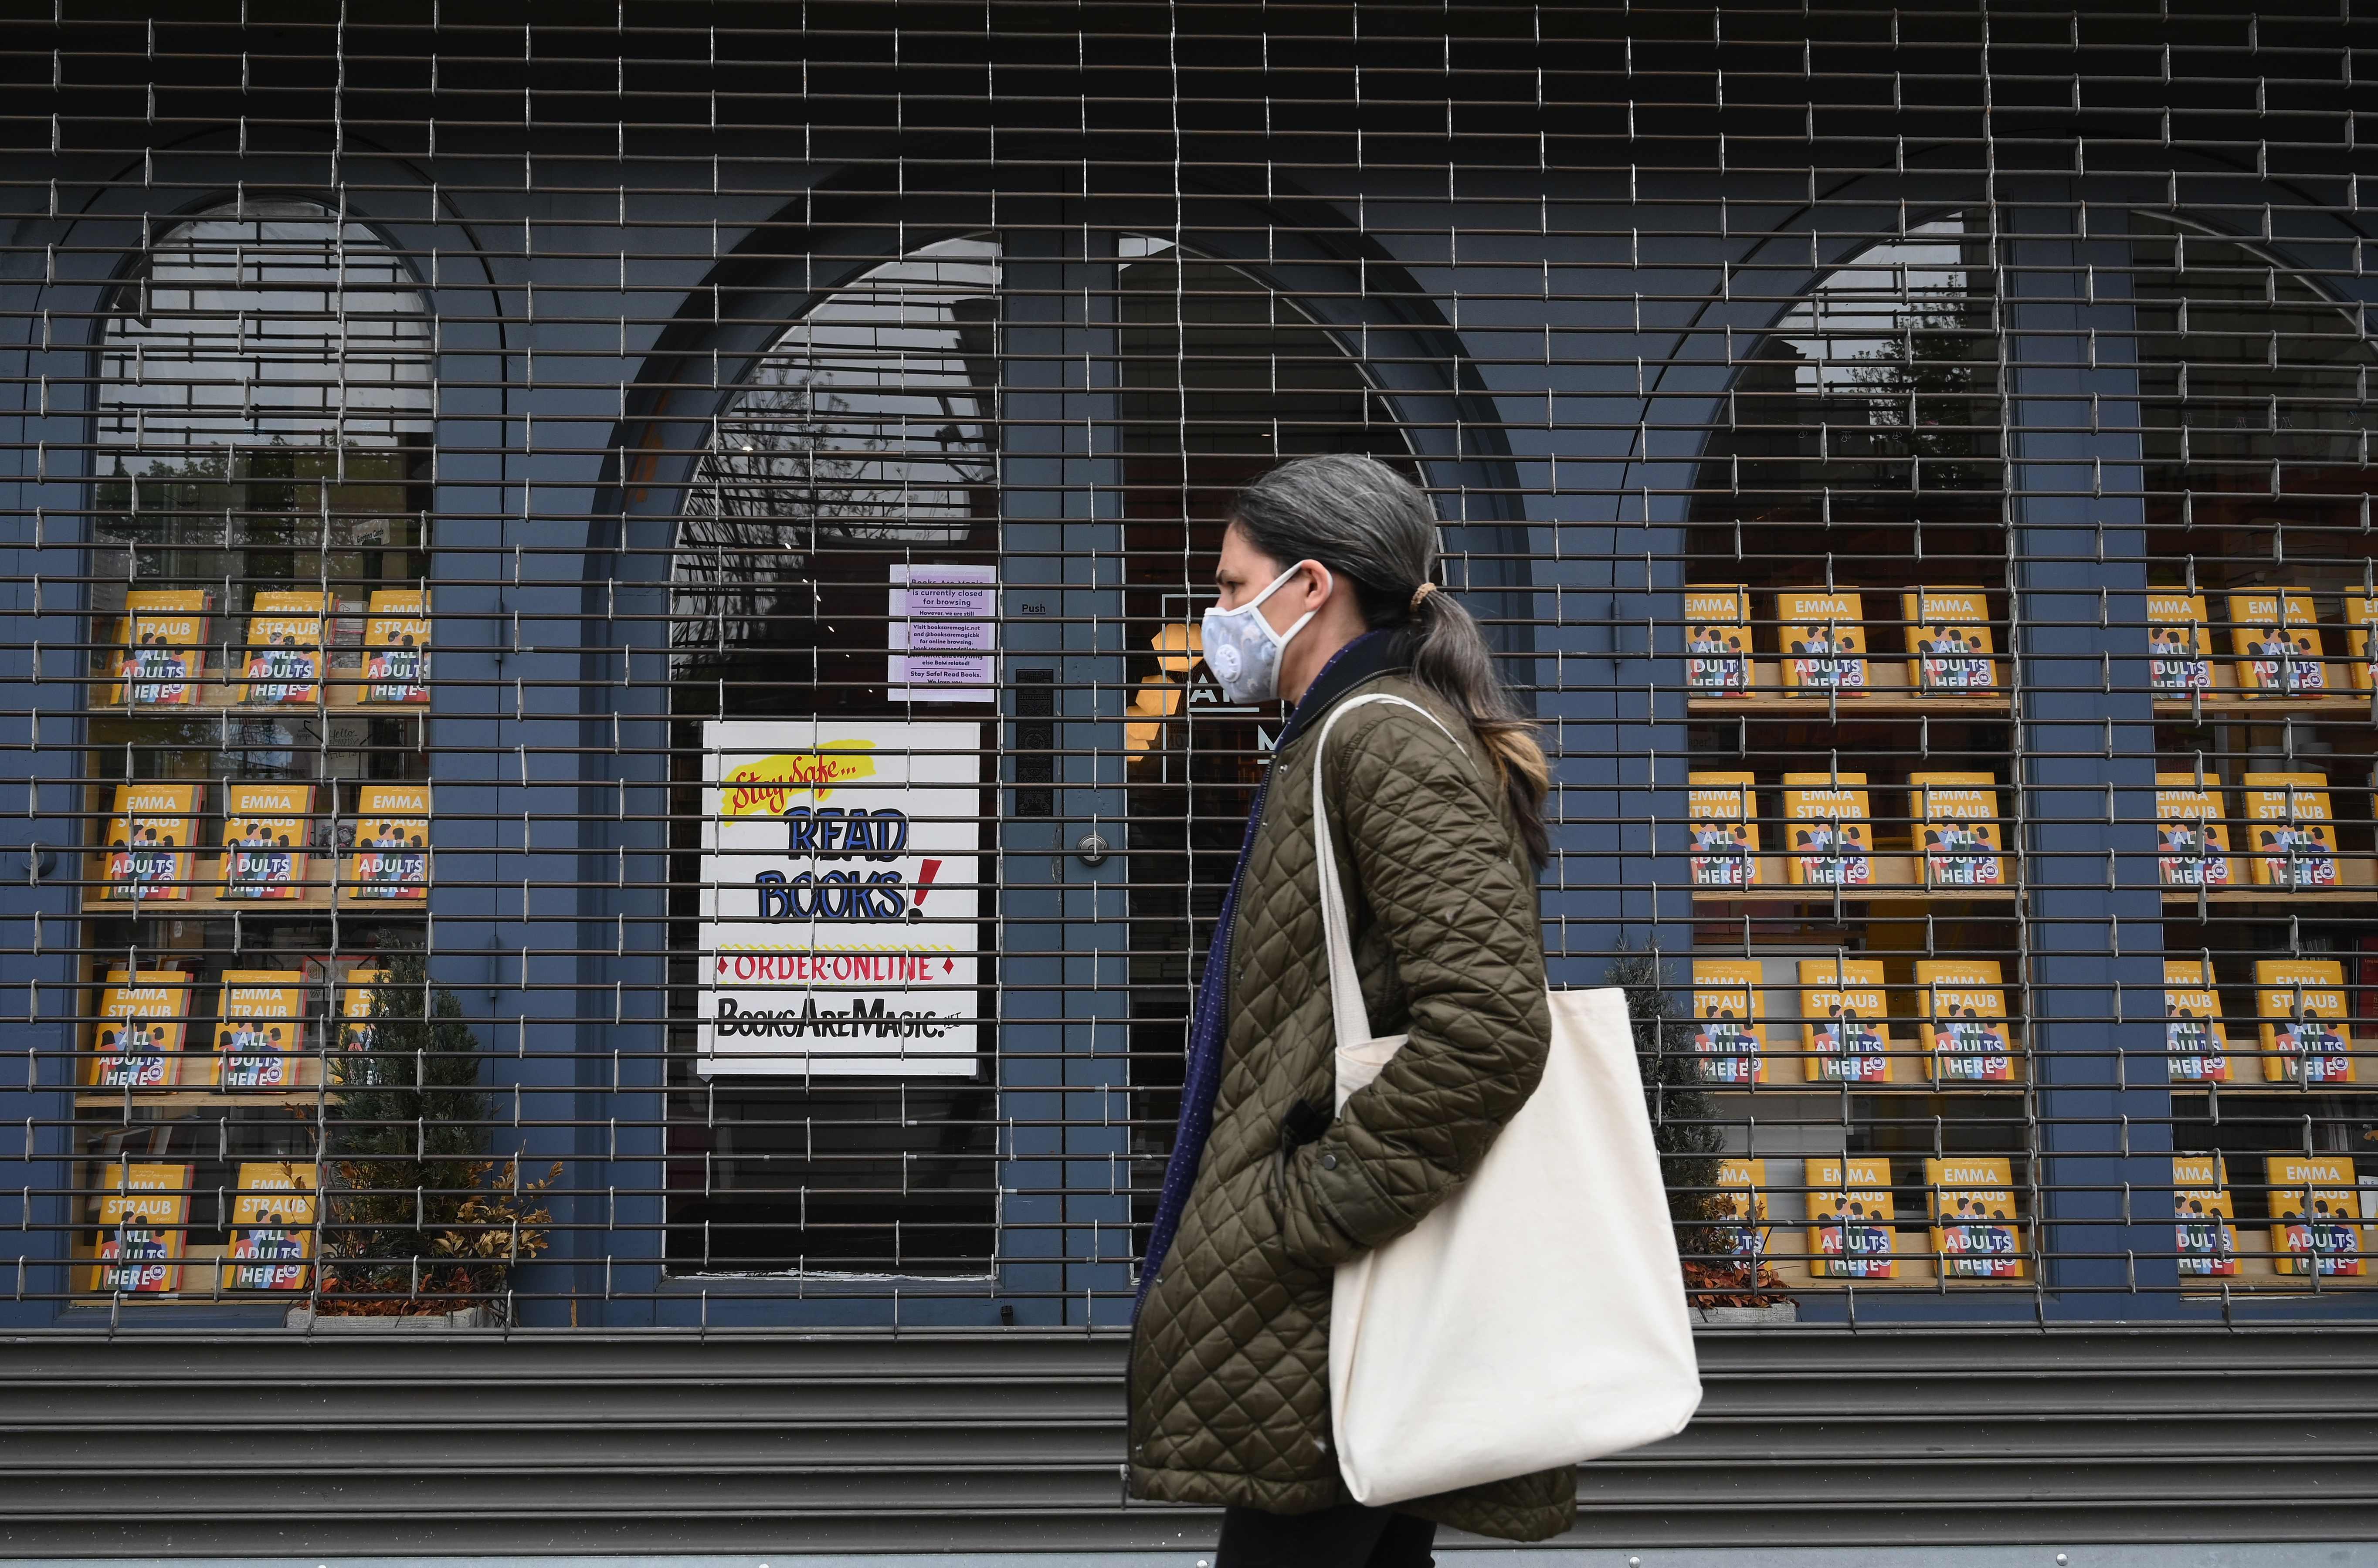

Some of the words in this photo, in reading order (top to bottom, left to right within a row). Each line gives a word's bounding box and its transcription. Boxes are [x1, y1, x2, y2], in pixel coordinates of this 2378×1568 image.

[936, 599, 971, 607] browsing
[1022, 603, 1046, 613] Push
[1685, 599, 1736, 612] EMMA
[1795, 600, 1848, 613] EMMA
[1923, 599, 1974, 612] EMMA
[2149, 601, 2192, 613] MMA
[137, 623, 190, 635] TRAUB
[256, 623, 319, 634] STRAUB
[1697, 641, 1727, 653] ALL
[1938, 641, 1968, 653] ALL
[2157, 643, 2186, 654] ALL
[2268, 643, 2298, 655] ALL
[139, 650, 169, 660] ALL
[248, 665, 312, 678] ADULTS
[1795, 660, 1860, 672] ADULTS
[1924, 660, 1988, 671] ADULTS
[2152, 662, 2206, 674] DULTS
[122, 667, 185, 678] ADULTS
[255, 684, 298, 696] HERE
[376, 685, 417, 696] HERE
[733, 772, 785, 816] Stay
[1689, 791, 1740, 800] EMMA
[1802, 791, 1854, 800] EMMA
[1929, 791, 1982, 800] EMMA
[127, 797, 176, 809] EMMA
[241, 796, 292, 809] EMMA
[373, 796, 423, 809] EMMA
[1796, 806, 1862, 818] STRAUB
[784, 806, 907, 862] READ
[1703, 831, 1733, 844] ALL
[1945, 831, 1975, 844] ALL
[2281, 832, 2311, 844] ALL
[110, 860, 174, 873] ADULTS
[359, 859, 423, 872] ADULTS
[1698, 870, 1743, 883] HERE
[1812, 870, 1856, 883] HERE
[1941, 870, 1985, 883] HERE
[2172, 870, 2215, 883] HERE
[117, 989, 168, 1000] EMMA
[232, 989, 282, 1000] EMMA
[1812, 994, 1879, 1007] STRAUB
[2166, 995, 2212, 1007] RAUB
[2272, 995, 2338, 1008] STAUB
[109, 1005, 171, 1016] STRAUB
[1709, 1024, 1740, 1036] ALL
[1953, 1023, 1983, 1033] ALL
[2170, 1023, 2200, 1033] ALL
[2293, 1023, 2324, 1035] ALL
[237, 1032, 266, 1046] ALL
[1938, 1040, 2003, 1051] ADULTS
[1705, 1062, 1749, 1076] HERE
[1828, 1061, 1872, 1075] HERE
[1951, 1059, 1995, 1074] HERE
[2169, 1060, 2213, 1073] HERE
[106, 1072, 148, 1085] HERE
[228, 1073, 267, 1085] HERE
[1944, 1168, 1998, 1182] EMMA
[2174, 1167, 2214, 1180] MMA
[2286, 1166, 2341, 1180] EMMA
[108, 1200, 171, 1214] STRAUB
[242, 1199, 306, 1213] STRAUB
[254, 1230, 284, 1241] ALL
[2178, 1233, 2231, 1247] DULTS
[2288, 1233, 2355, 1247] ADULTS
[1946, 1235, 2012, 1250] ADULTS
[234, 1247, 300, 1259] ADULTS
[1960, 1259, 2004, 1270] HERE
[108, 1270, 150, 1285] HERE
[241, 1268, 285, 1283] HERE
